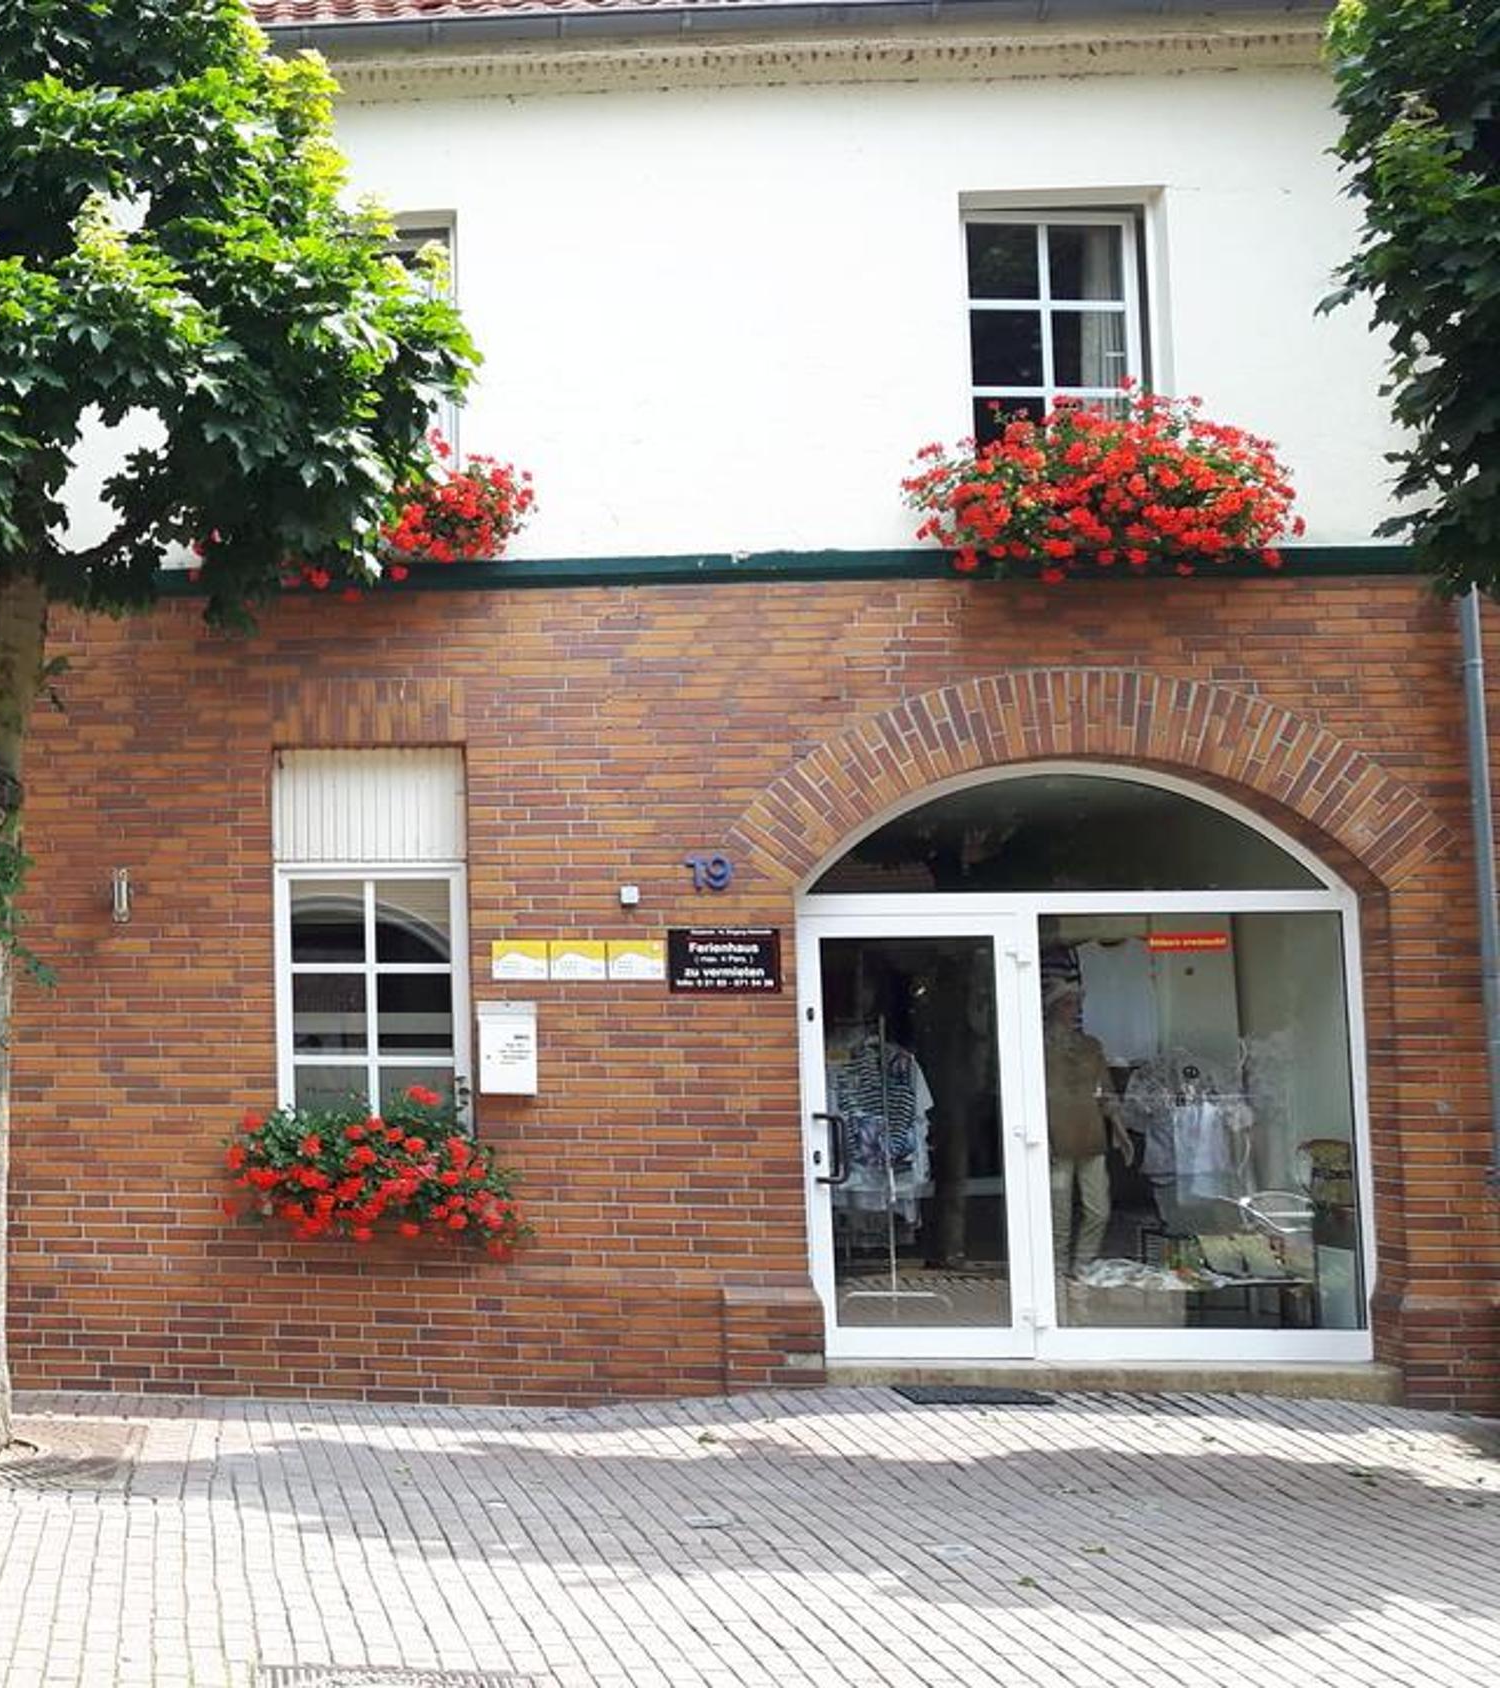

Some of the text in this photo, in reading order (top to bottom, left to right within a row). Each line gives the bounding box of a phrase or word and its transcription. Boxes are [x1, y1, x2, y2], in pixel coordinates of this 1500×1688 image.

[684, 853, 733, 891] 19
[688, 942, 760, 954] Ferienhaus
[684, 966, 766, 978] zu vermieten
